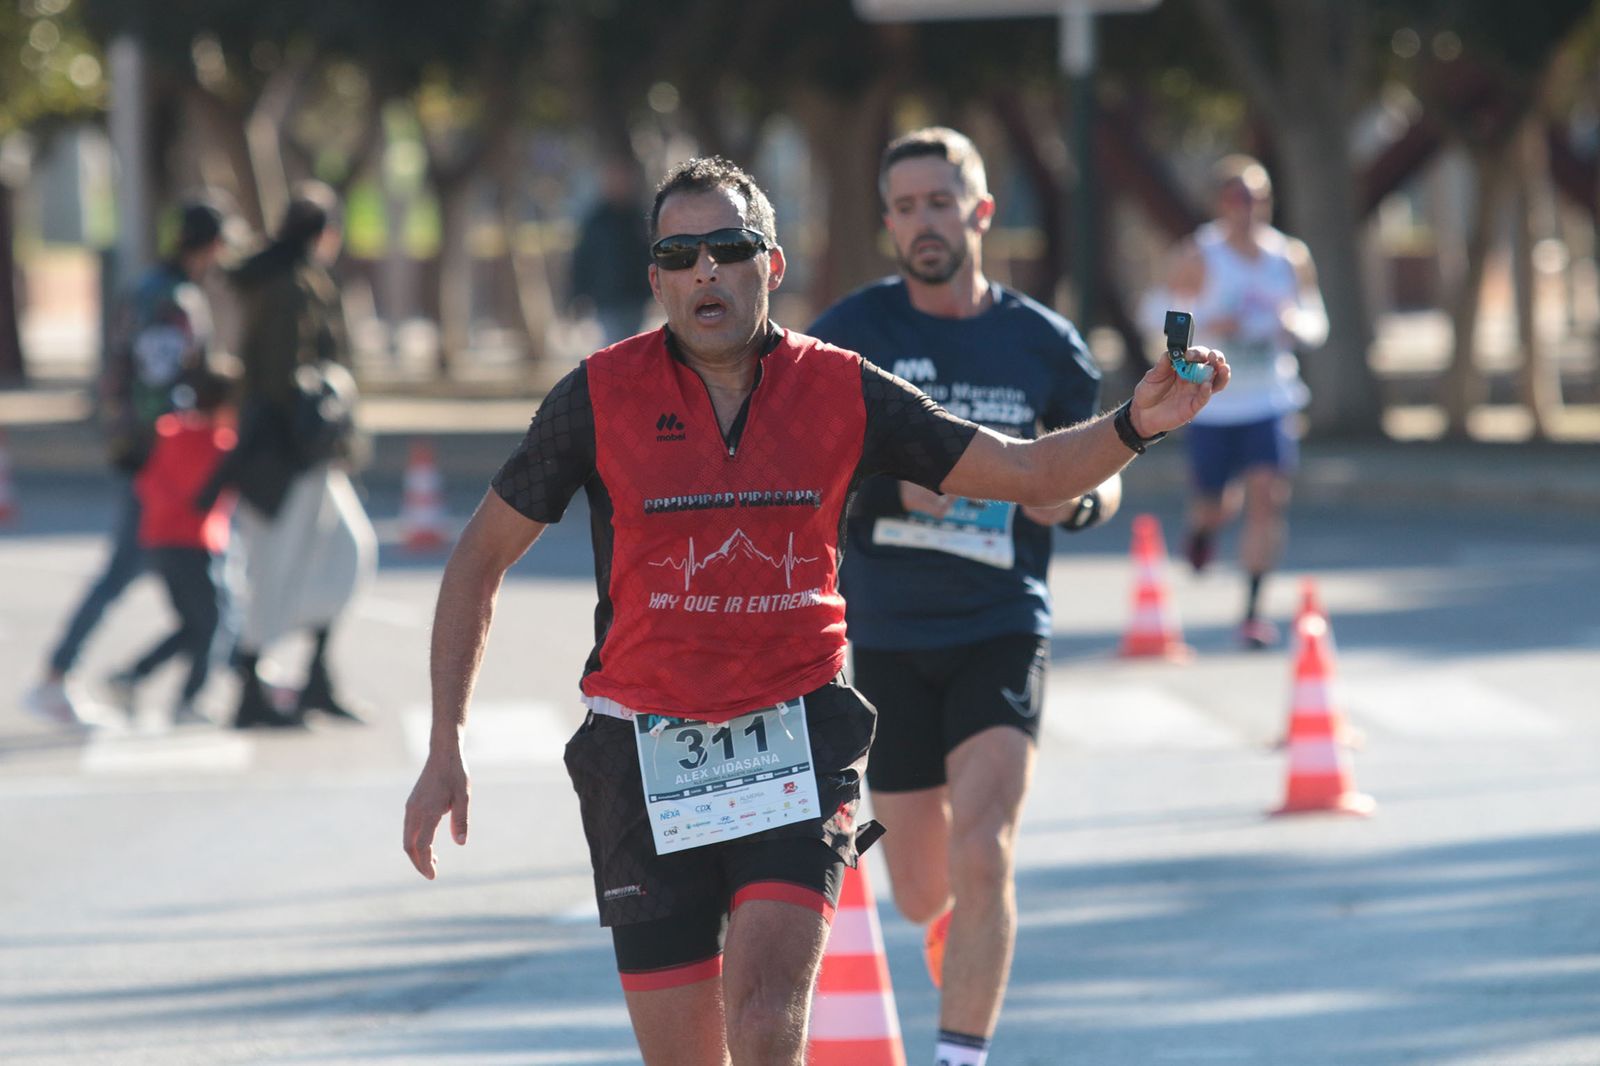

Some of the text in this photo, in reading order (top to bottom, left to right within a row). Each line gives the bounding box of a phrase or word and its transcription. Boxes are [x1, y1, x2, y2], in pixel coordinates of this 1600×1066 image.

[656, 432, 686, 442] mobel
[649, 591, 681, 610] HAY
[683, 594, 720, 613] QUE
[724, 595, 744, 613] IR
[675, 714, 768, 770] 311
[675, 752, 780, 785] ALEX VIDASANA
[660, 809, 680, 821] NEXA
